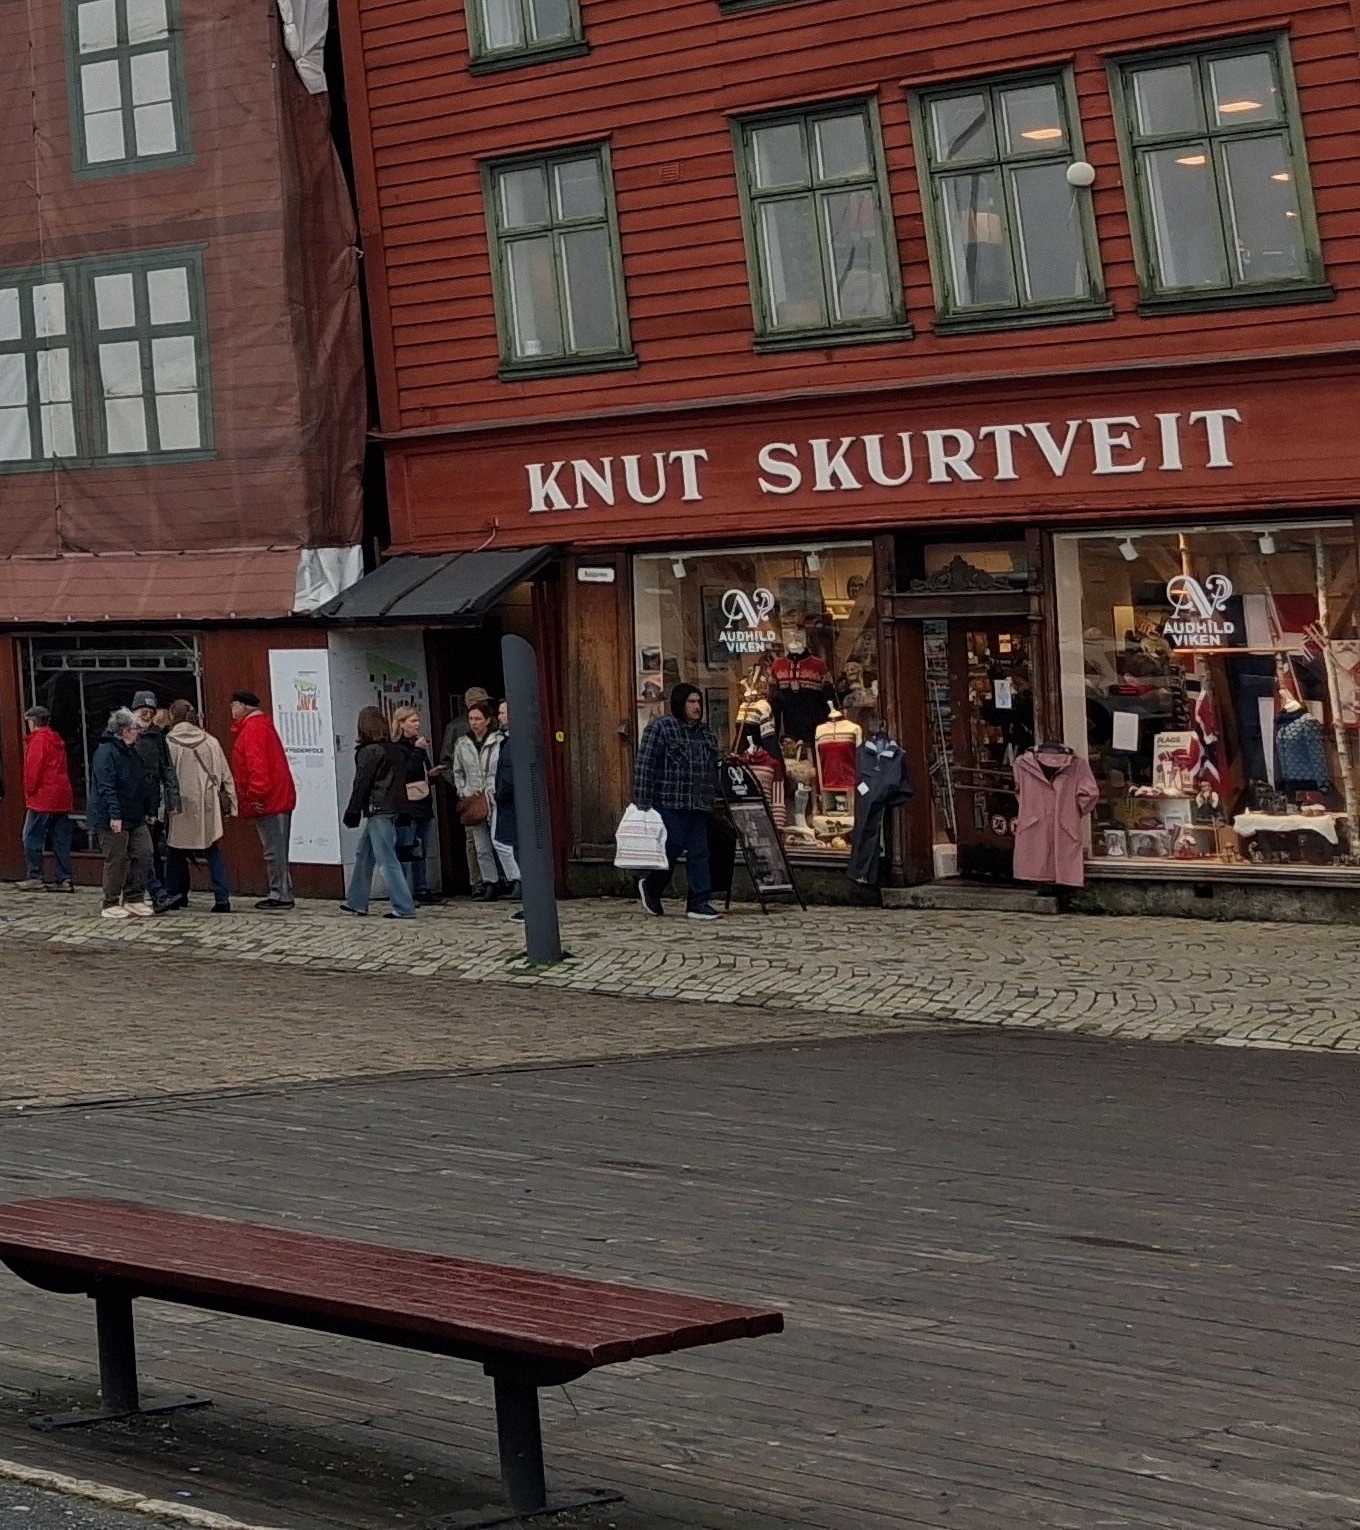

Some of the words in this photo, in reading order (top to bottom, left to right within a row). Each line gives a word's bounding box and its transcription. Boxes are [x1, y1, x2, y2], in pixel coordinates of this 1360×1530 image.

[524, 449, 708, 513] KNUT
[757, 408, 1242, 495] SKURTVEIT
[1162, 621, 1235, 635] AUDHILD
[719, 630, 776, 642] AUDHILD
[1172, 634, 1221, 647] VIKEN
[726, 641, 766, 653] VIKEN
